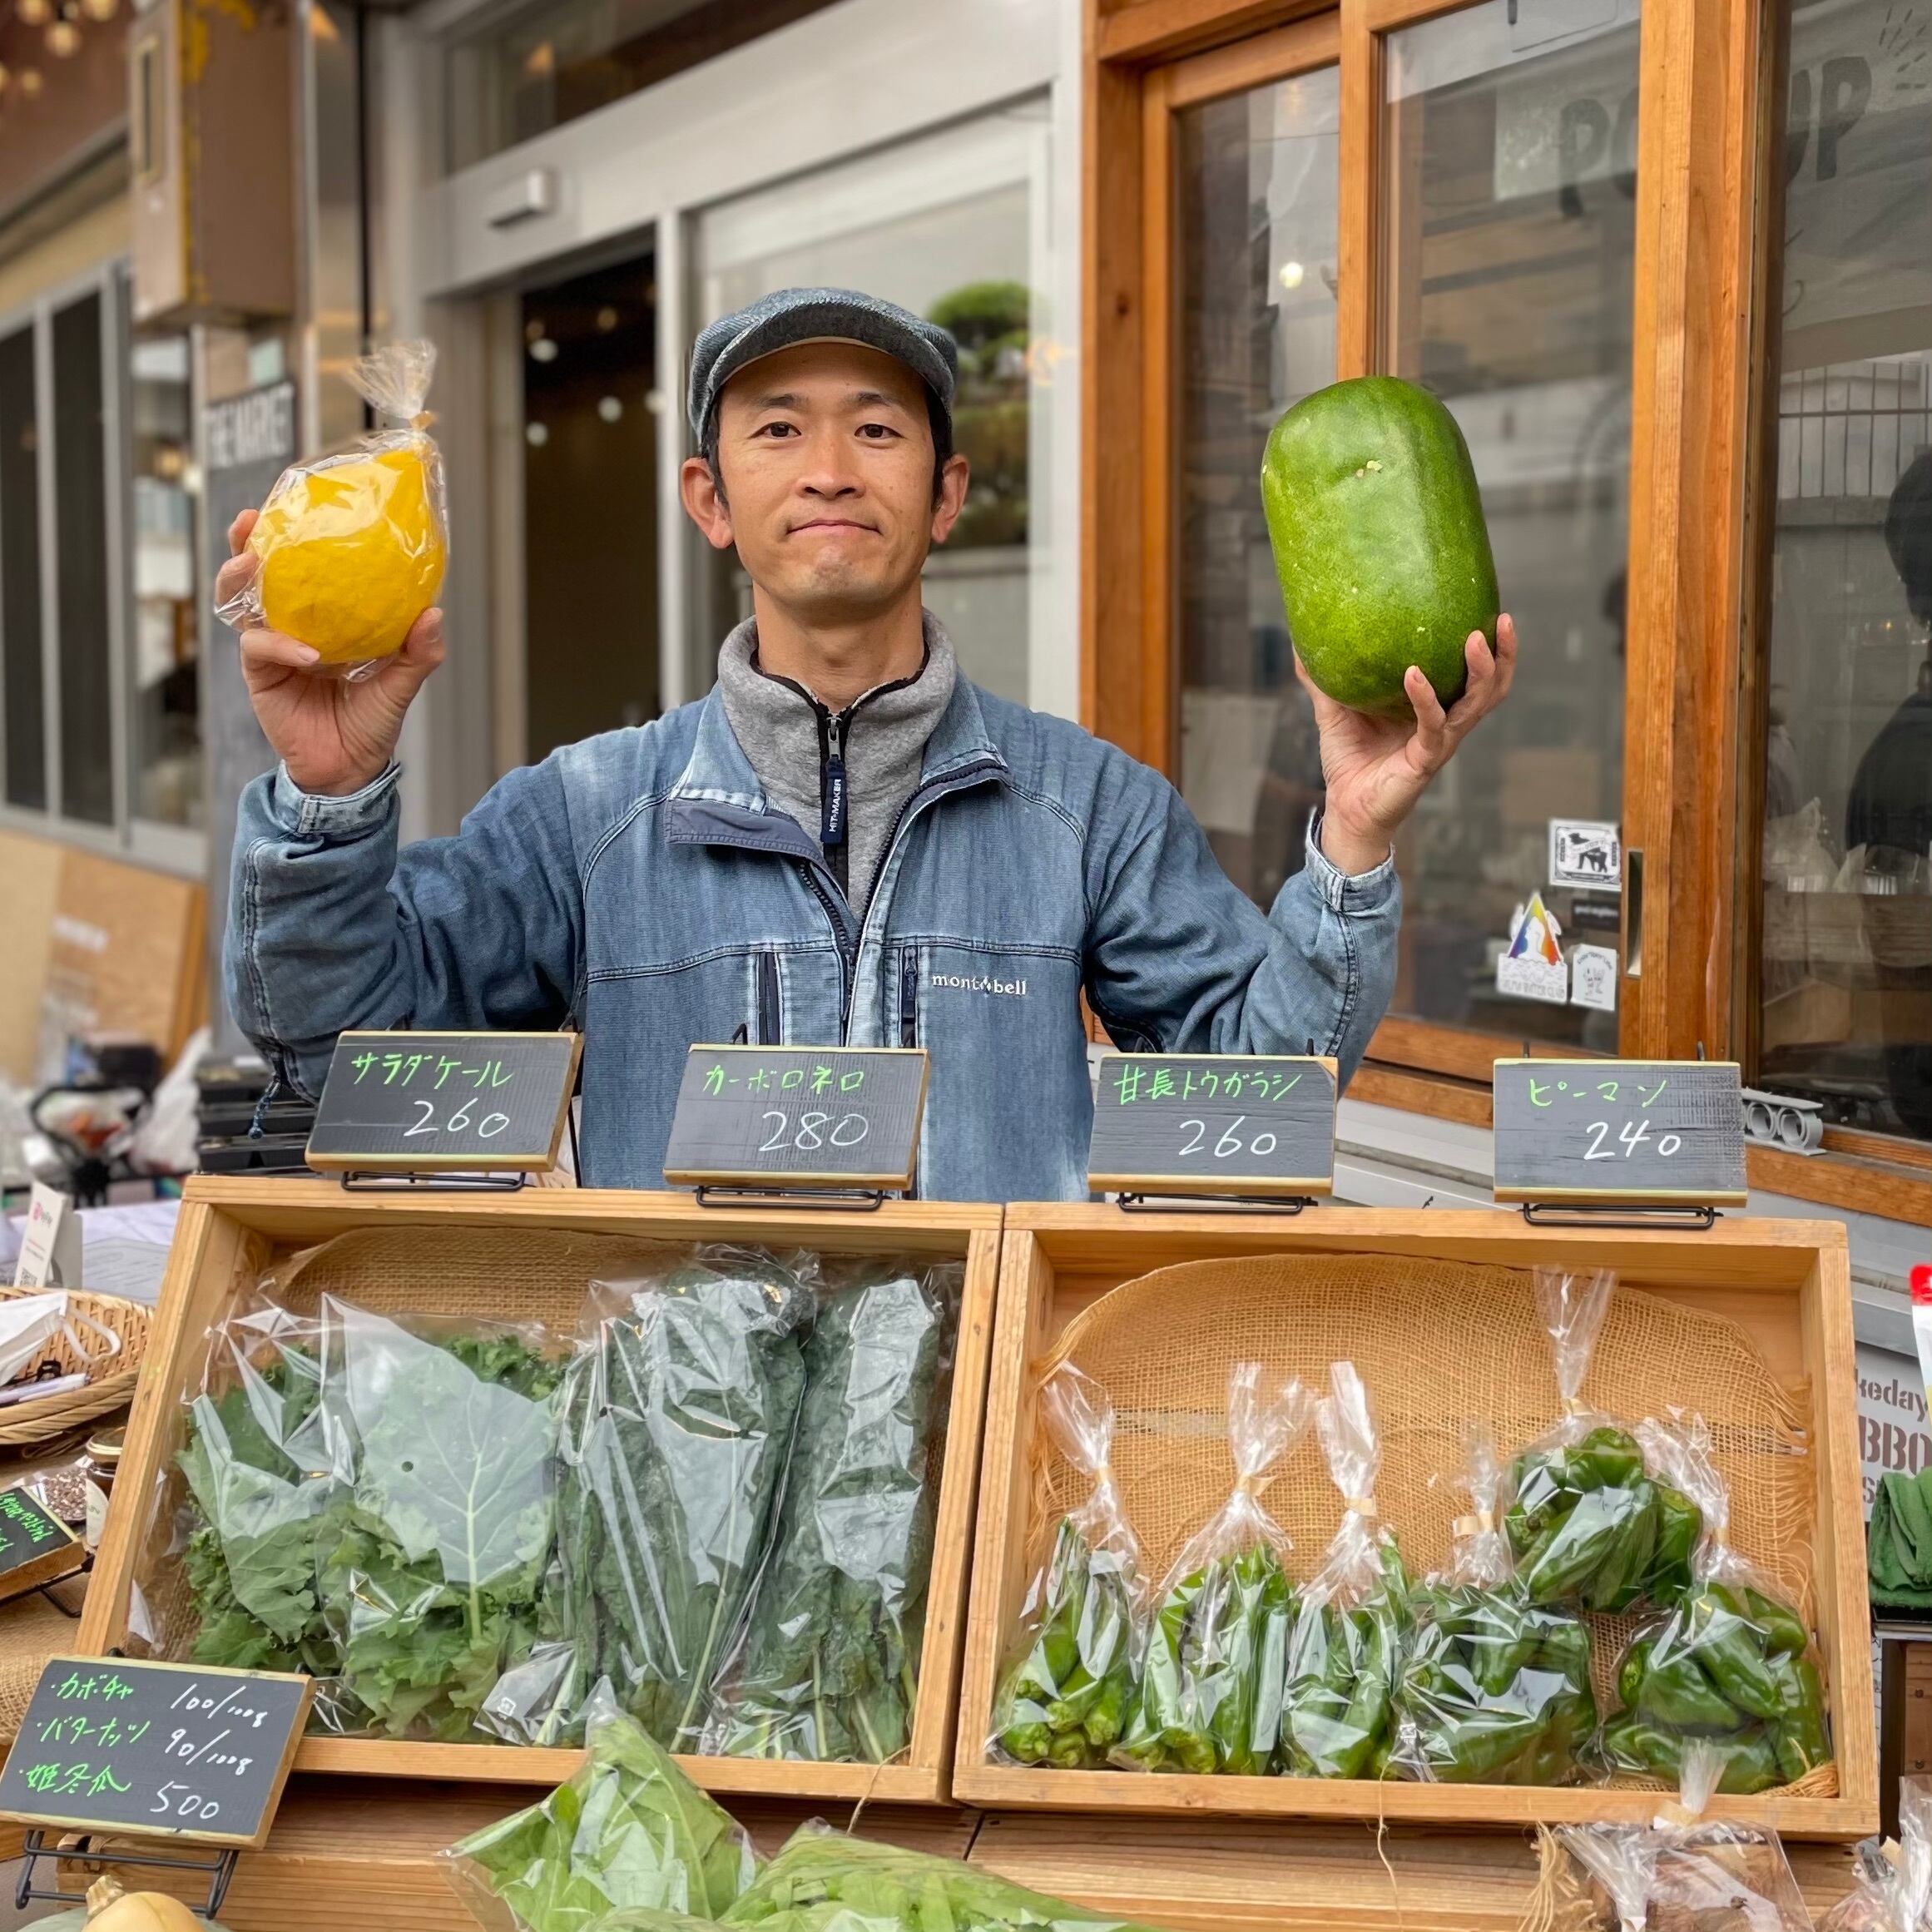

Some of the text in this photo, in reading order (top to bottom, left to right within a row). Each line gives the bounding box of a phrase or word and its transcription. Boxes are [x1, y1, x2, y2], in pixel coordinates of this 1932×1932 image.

[351, 1053, 514, 1089] サラダケール
[704, 1064, 864, 1094] カーボロネロ
[1114, 1064, 1302, 1105] 甘長トウガラシ
[1528, 1078, 1667, 1107] ピーマン
[404, 1097, 511, 1138] 260
[759, 1111, 869, 1152] 280
[1178, 1116, 1276, 1157] 260
[1583, 1119, 1682, 1161] 240
[150, 1781, 220, 1820] 500
